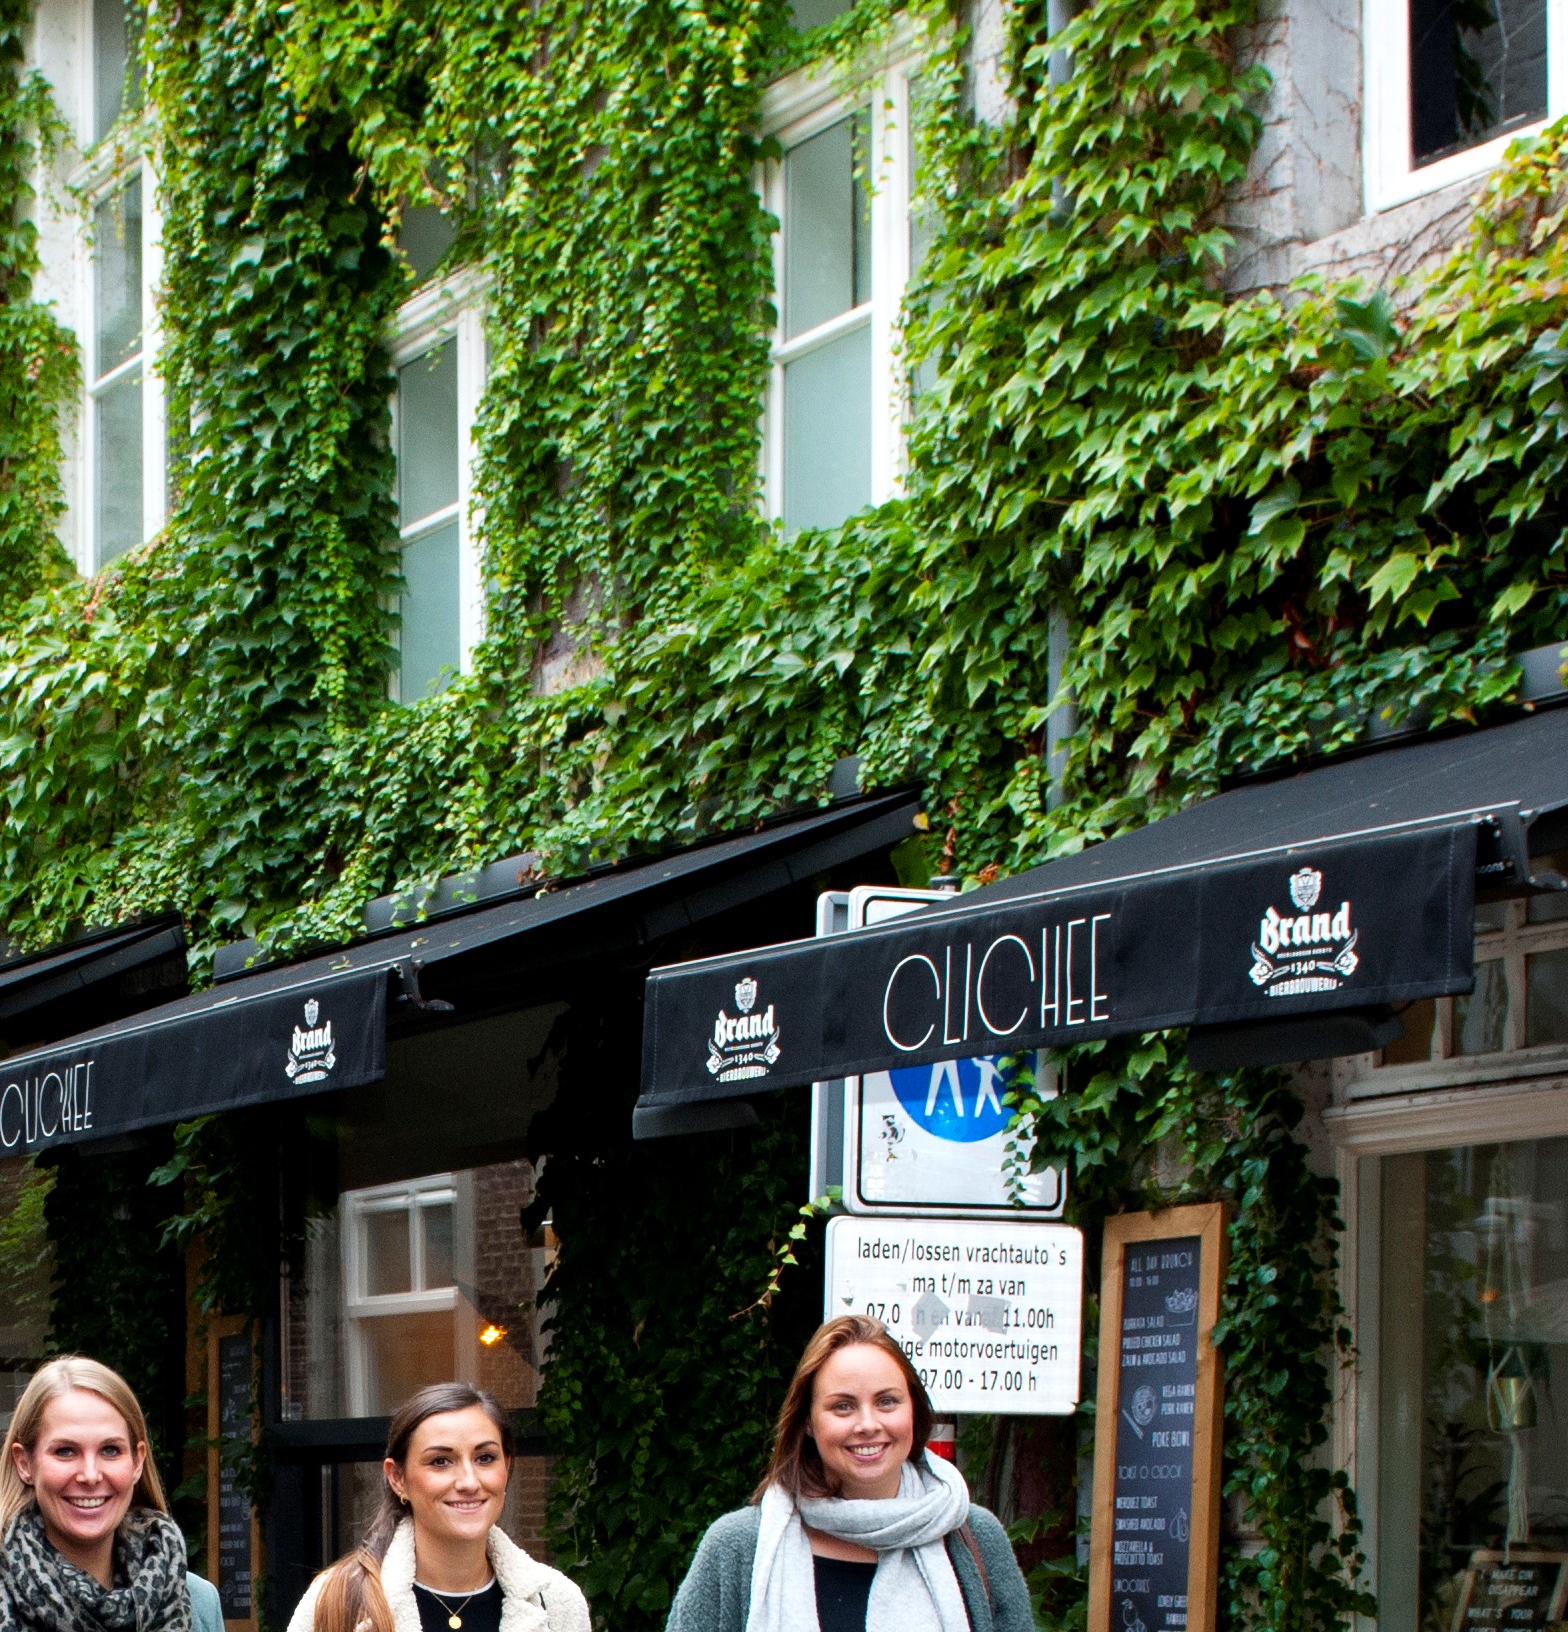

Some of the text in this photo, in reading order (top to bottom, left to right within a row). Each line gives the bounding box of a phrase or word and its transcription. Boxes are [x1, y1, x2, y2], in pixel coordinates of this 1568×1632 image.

[1260, 901, 1350, 954] Brand
[1290, 960, 1315, 975] 1340
[883, 914, 1112, 1052] CLICHEE
[292, 1020, 331, 1057] Brand
[714, 1004, 774, 1048] Brand
[735, 1052, 753, 1065] 1340
[0, 1060, 94, 1147] CLICHEE
[858, 1237, 960, 1264] laden/lossen
[912, 1272, 1026, 1298] ma t/m za van
[1003, 1308, 1055, 1330] 11.00h
[929, 1338, 1059, 1365] motorvoertuigen
[980, 1370, 1023, 1391] 17.00
[1028, 1370, 1037, 1391] h
[1488, 1585, 1539, 1596] DISAPPEAR
